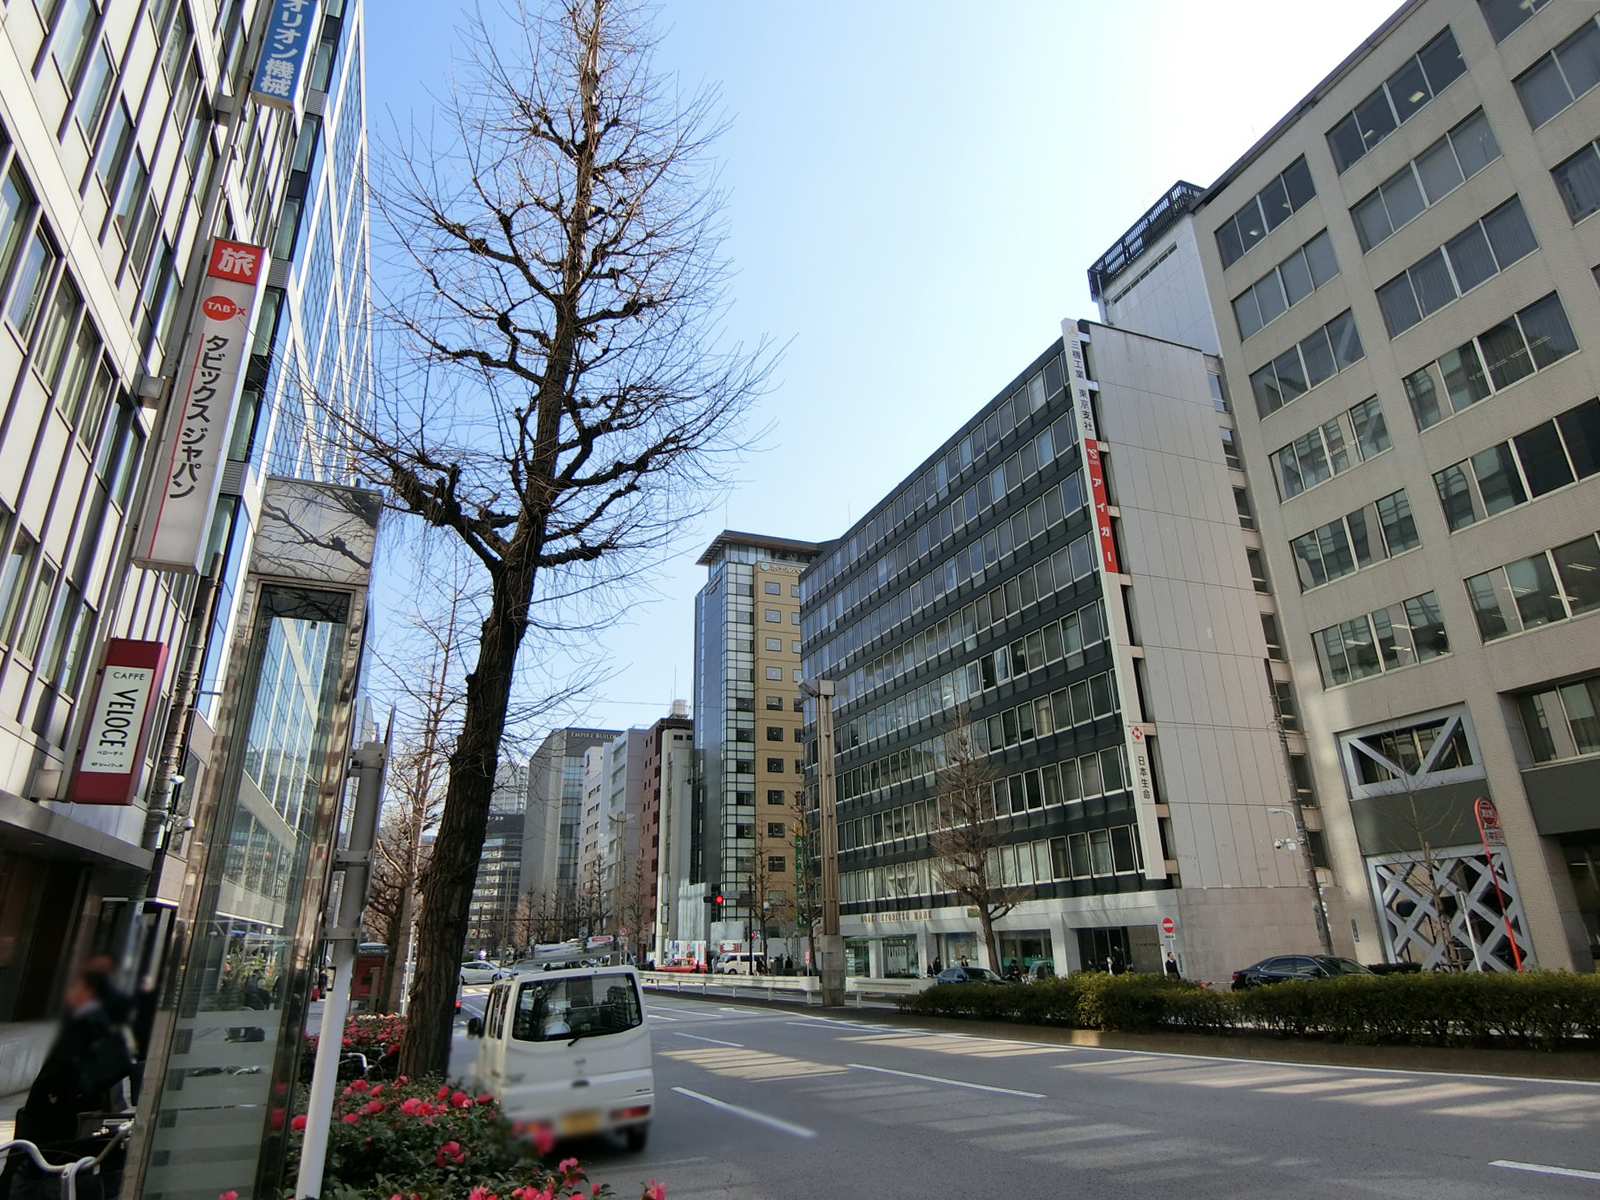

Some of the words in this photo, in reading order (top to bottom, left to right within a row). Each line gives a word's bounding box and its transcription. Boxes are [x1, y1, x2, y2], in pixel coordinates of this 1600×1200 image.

[261, 0, 309, 97] オリオン機械
[217, 247, 256, 277] 旅
[1078, 388, 1094, 432] 東京支社
[1092, 477, 1112, 563] アイガー
[98, 688, 139, 748] VELOCE
[571, 731, 594, 739] EMPIRE
[1137, 755, 1151, 800] 日本生命
